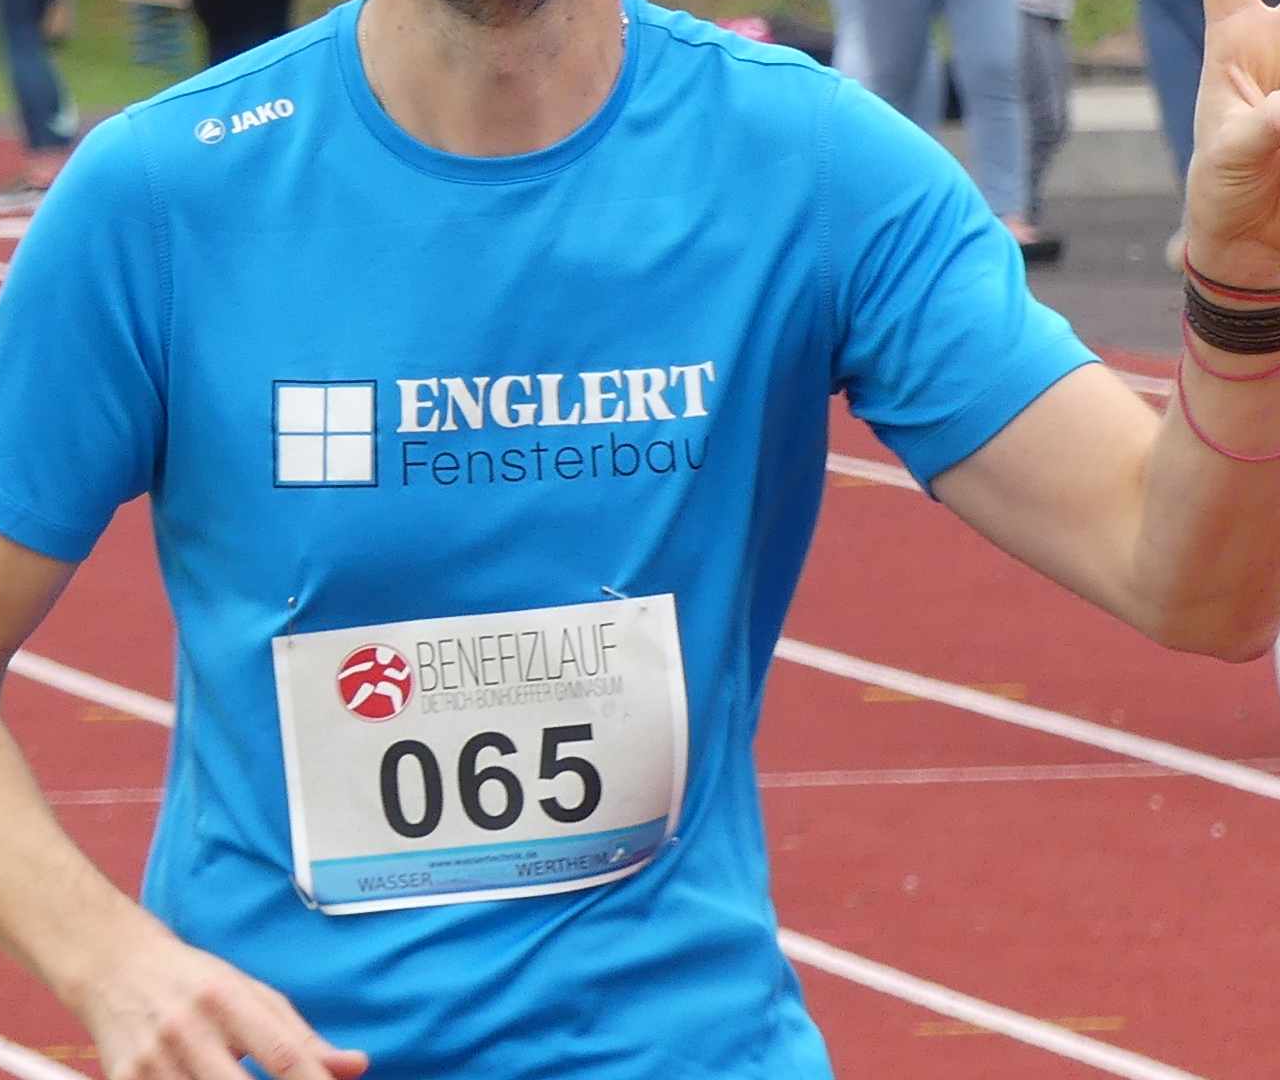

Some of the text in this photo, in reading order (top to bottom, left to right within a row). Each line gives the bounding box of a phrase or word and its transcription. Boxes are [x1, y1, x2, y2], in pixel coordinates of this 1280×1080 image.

[231, 99, 294, 134] JAKO
[396, 361, 715, 433] ENGLERT
[400, 431, 710, 486] Fensterbau
[416, 622, 617, 692] BENEFIZLAUF
[380, 723, 602, 839] 065
[357, 871, 432, 893] WASSER
